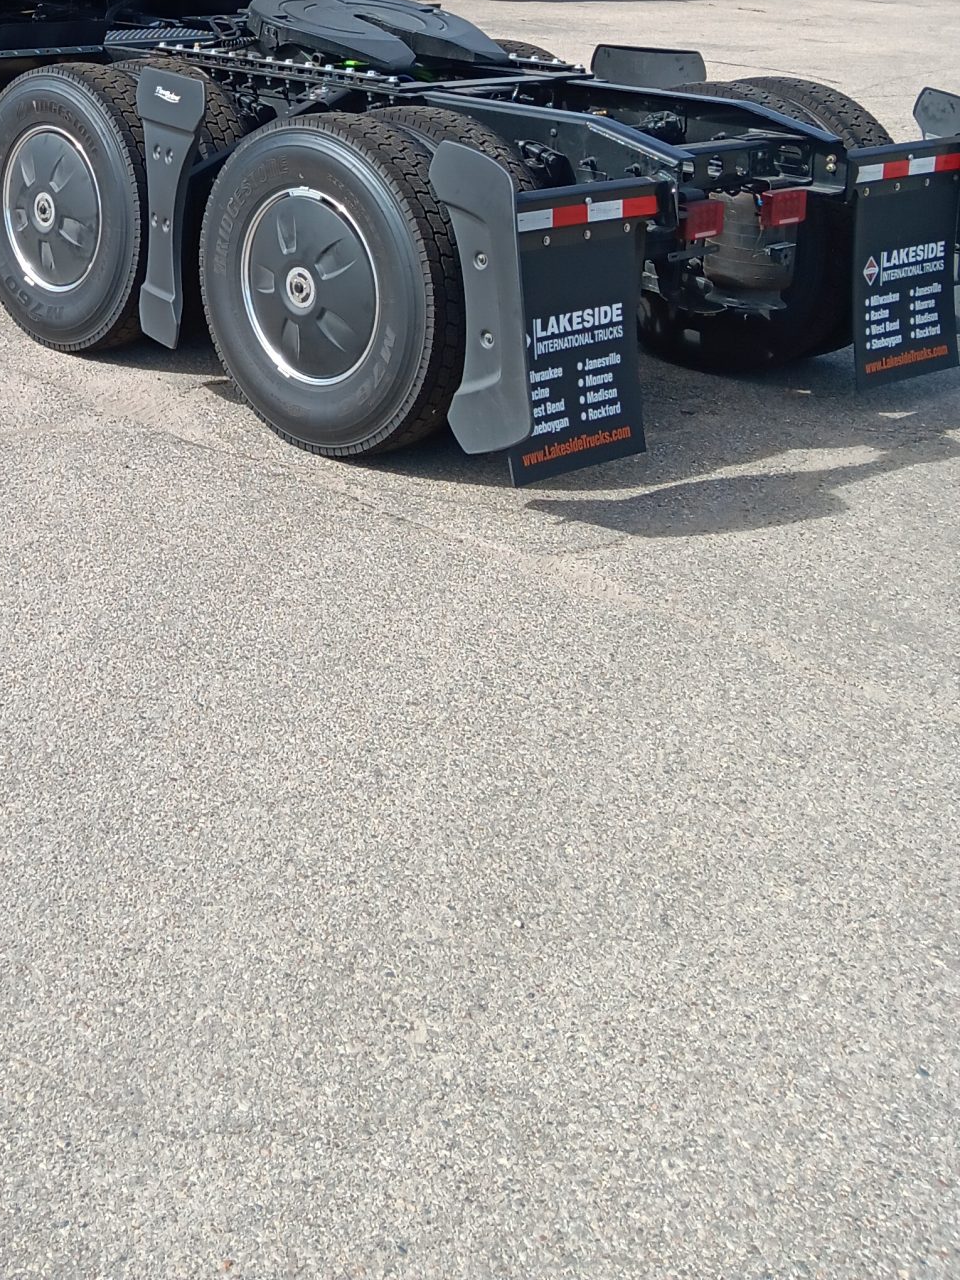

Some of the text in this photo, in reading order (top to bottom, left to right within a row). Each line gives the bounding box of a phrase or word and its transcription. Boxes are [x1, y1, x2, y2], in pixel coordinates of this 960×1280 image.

[883, 241, 945, 268] LAKESIDE
[883, 264, 923, 282] INTERNATIONAL
[923, 260, 945, 273] TRUCKS
[536, 302, 623, 338] LAKESIDE
[870, 308, 889, 321] Racine
[870, 318, 900, 335] West Bend
[915, 323, 941, 339] Rockford
[537, 325, 624, 355] INTERNATIONAL TRUCKS
[584, 352, 621, 371] Janesville
[529, 366, 563, 384] ilwaukee
[585, 372, 613, 388] Monroe
[586, 387, 618, 404] Madison
[533, 397, 566, 418] est Bend
[588, 401, 621, 421] Rockford
[531, 417, 570, 437] heboygan
[522, 425, 631, 467] www.LakesideTrucks.com
